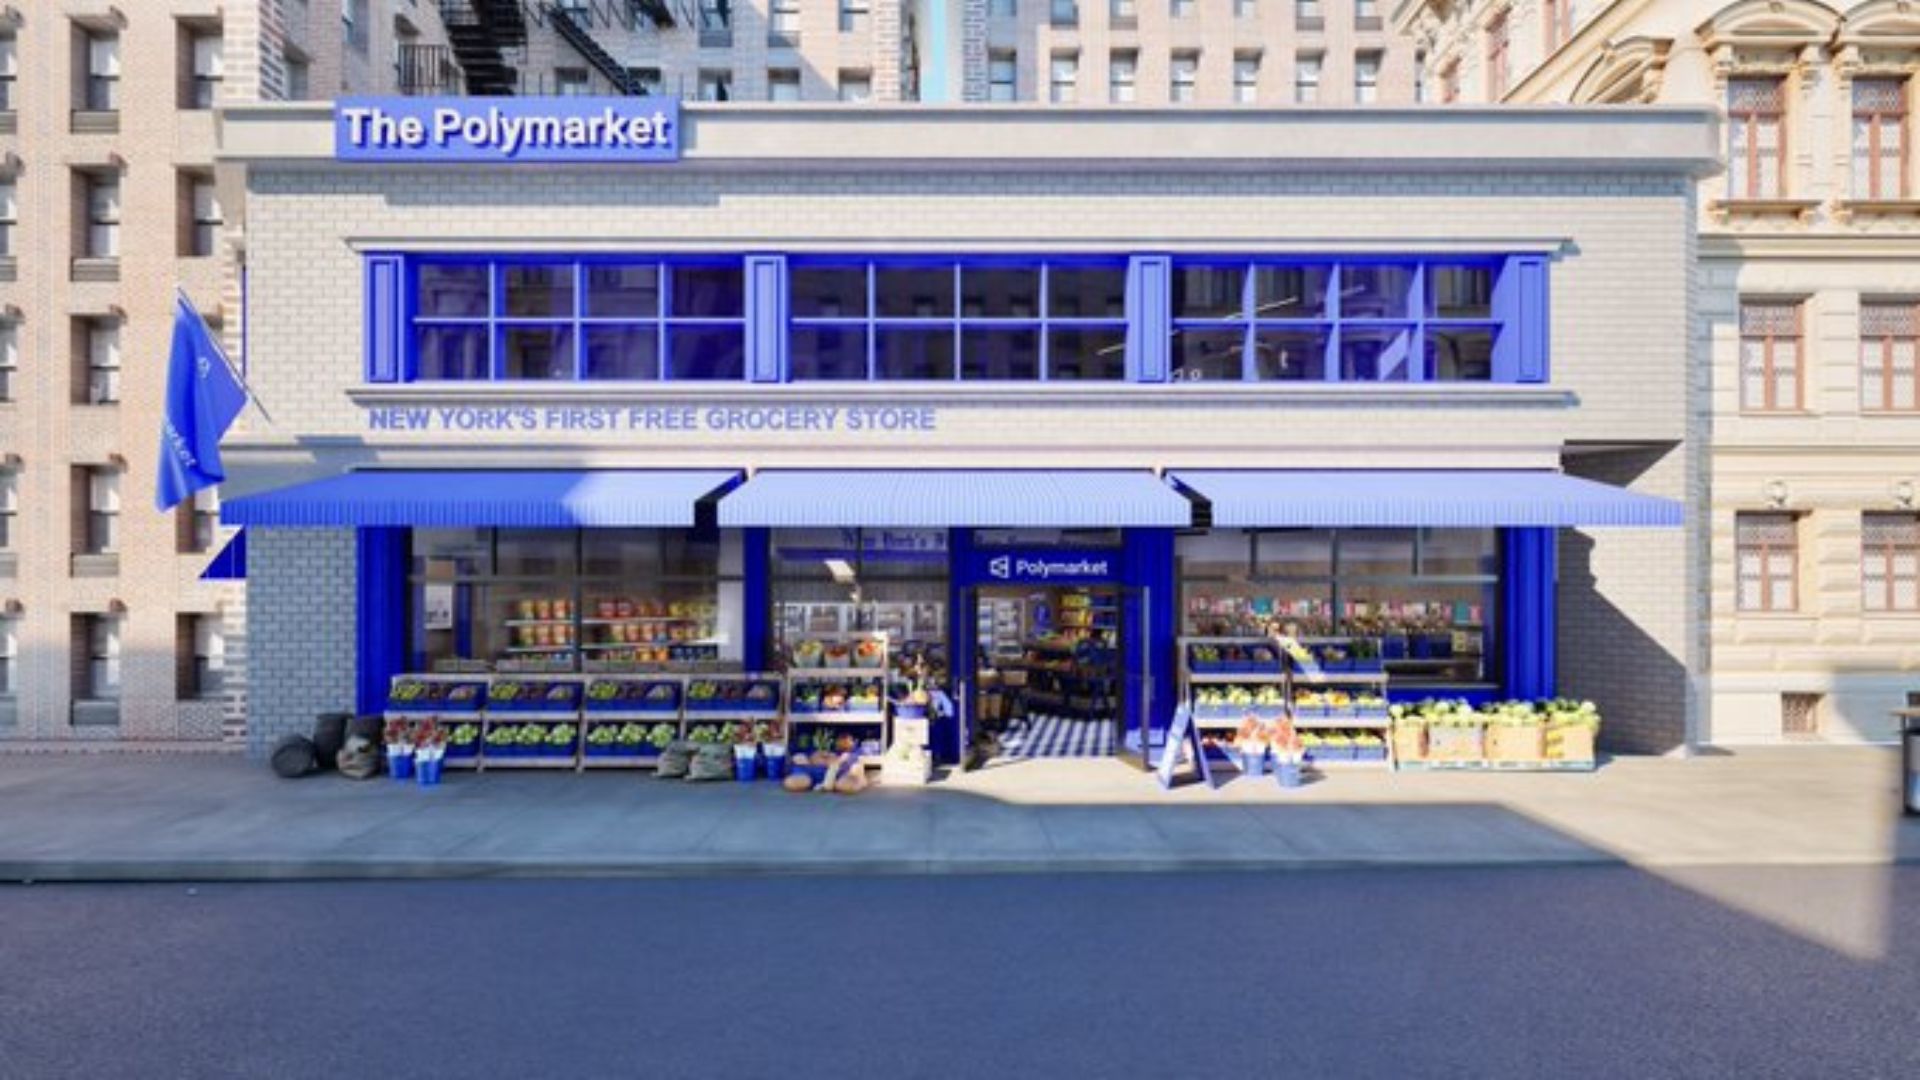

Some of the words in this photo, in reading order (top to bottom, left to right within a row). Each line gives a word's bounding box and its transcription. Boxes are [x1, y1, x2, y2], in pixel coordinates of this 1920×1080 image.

[342, 107, 426, 146] The
[433, 106, 669, 154] Polymarket
[368, 408, 431, 430] NEW
[439, 408, 537, 430] YORK'S
[545, 408, 620, 430] FIRST
[628, 408, 698, 430] FREE
[705, 408, 839, 430] GROCERY
[846, 408, 937, 430] STORE
[1016, 558, 1108, 579] Polymarket
